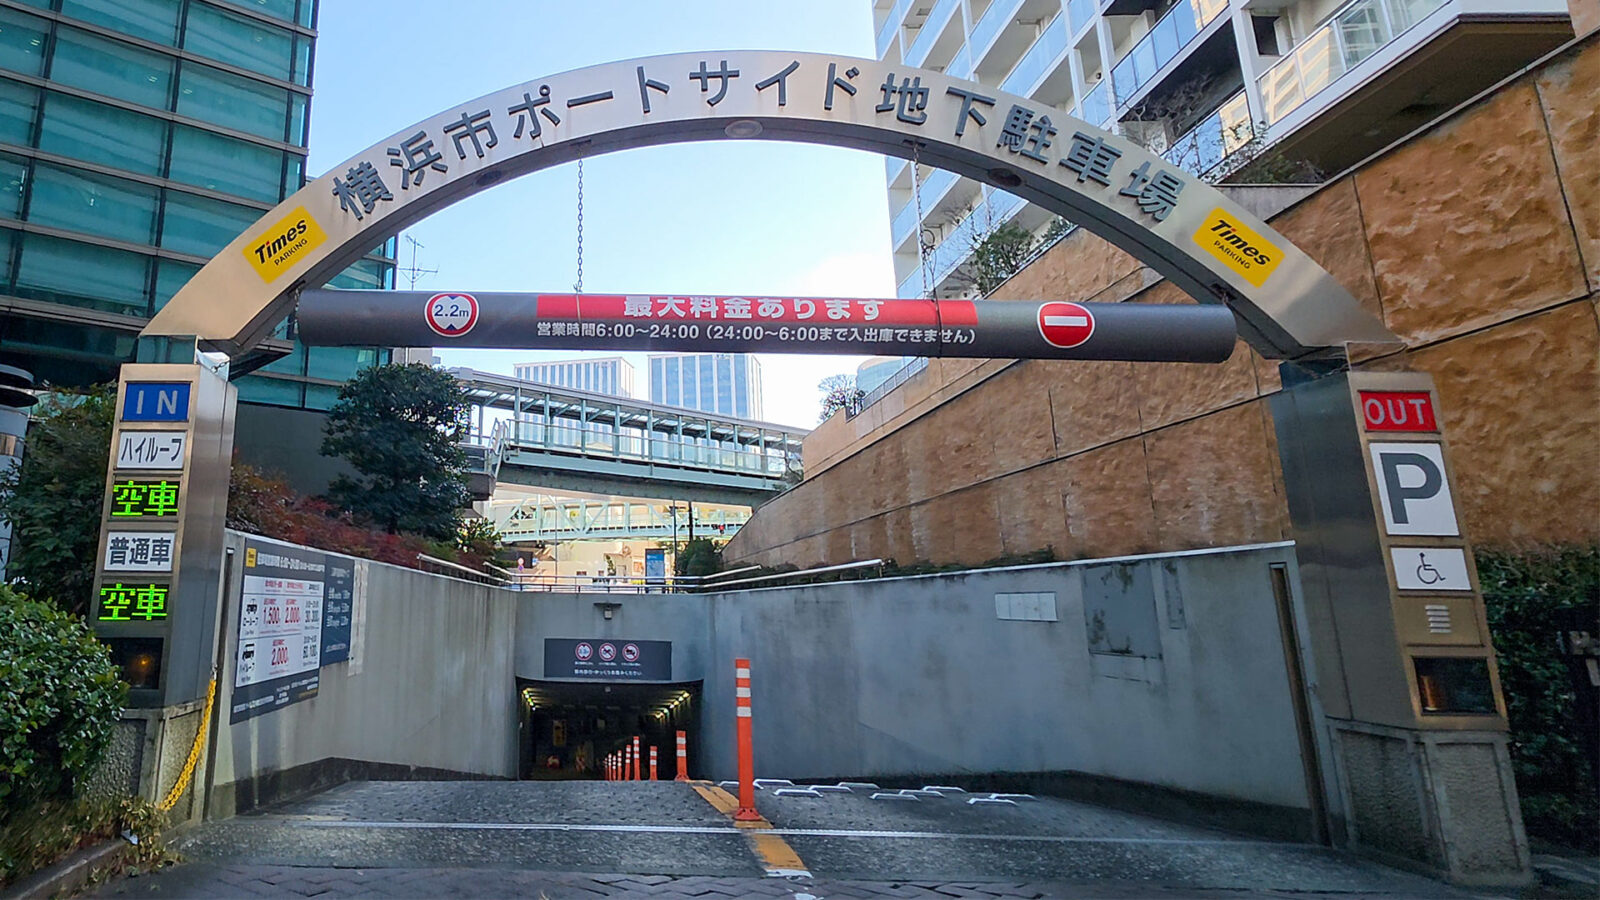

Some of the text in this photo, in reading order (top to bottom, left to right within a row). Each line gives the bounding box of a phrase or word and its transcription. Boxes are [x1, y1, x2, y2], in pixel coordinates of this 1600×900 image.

[332, 59, 1186, 221] 横浜市ポートサイド地下駐車場
[254, 219, 307, 265] Times
[274, 238, 308, 266] PARKING
[1210, 219, 1271, 266] Times
[1213, 240, 1252, 269] PARKING
[434, 304, 469, 317] 2.2m
[623, 297, 885, 320] 最大料金あります
[136, 390, 178, 415] IN
[1364, 398, 1426, 425] OUT
[120, 437, 183, 463] ハイルーフ
[111, 480, 179, 517] 空車
[1379, 452, 1442, 524] P
[109, 536, 172, 566] 普通車
[98, 583, 169, 621] 空車
